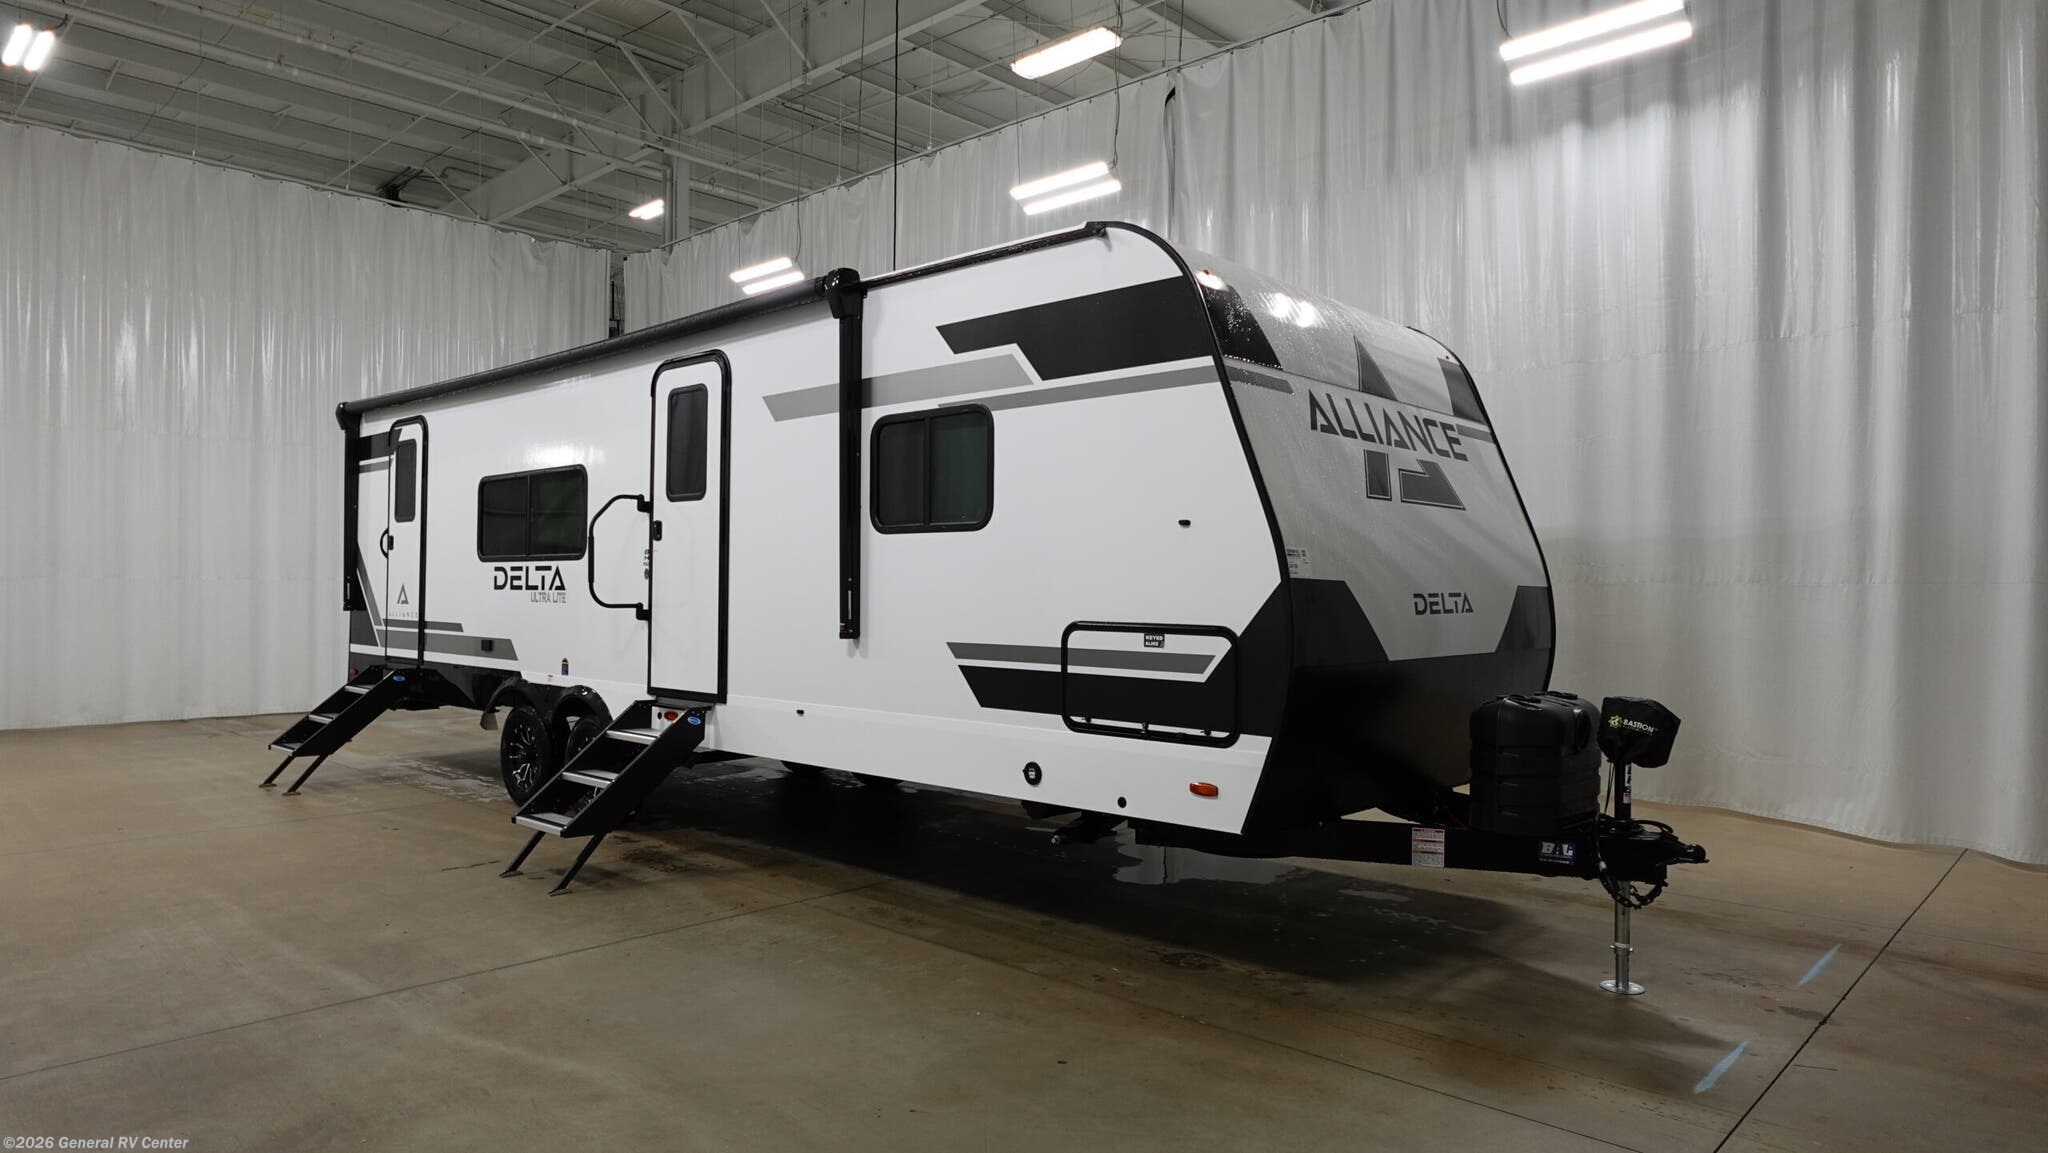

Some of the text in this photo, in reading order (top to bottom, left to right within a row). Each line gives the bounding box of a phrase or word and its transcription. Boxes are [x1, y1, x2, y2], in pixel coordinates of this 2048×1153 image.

[1309, 389, 1469, 461] ALLIANCE
[494, 566, 566, 591] DELTA
[530, 591, 567, 604] ULTRA LITE
[1413, 593, 1474, 616] DELTA
[1623, 718, 1655, 733] BASTION
